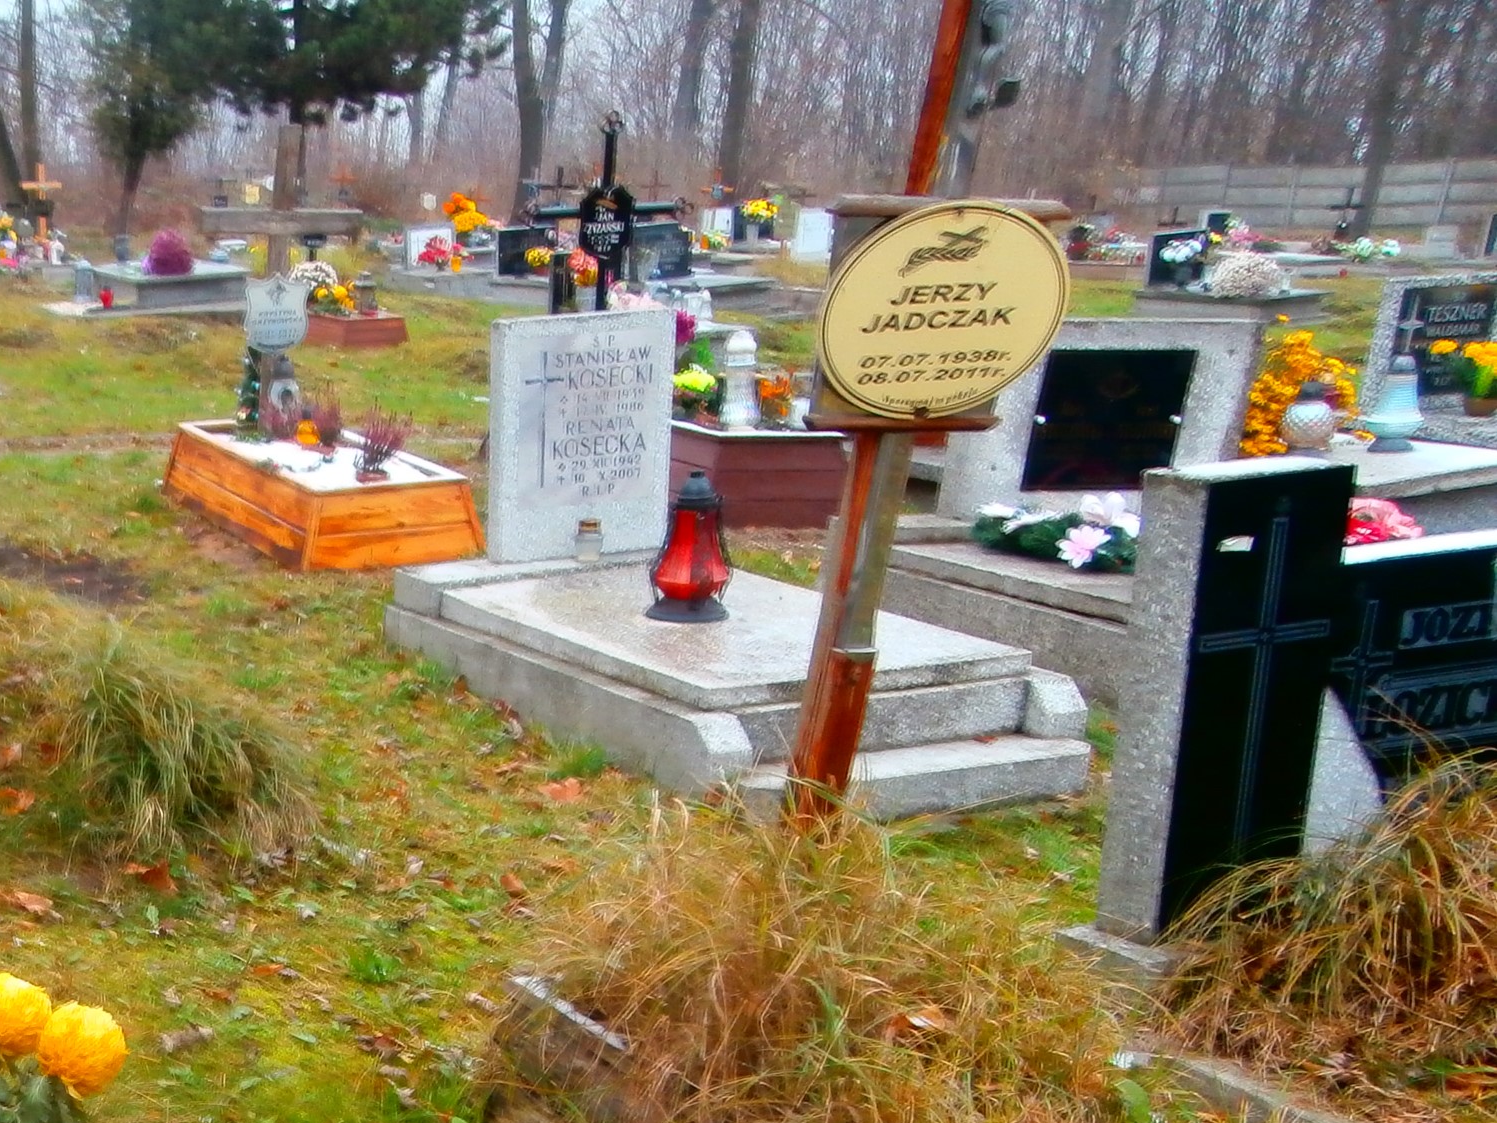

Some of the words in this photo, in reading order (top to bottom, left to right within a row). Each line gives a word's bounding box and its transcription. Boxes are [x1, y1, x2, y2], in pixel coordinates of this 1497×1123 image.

[890, 281, 998, 306] JERZY
[861, 307, 1017, 335] JADCZAK
[1427, 303, 1488, 323] TESZNER
[555, 345, 652, 369] STANISŁAW
[859, 350, 1011, 370] 07.07.1938r.
[568, 363, 653, 390] KOSECKI
[857, 367, 1006, 386] 08.07.2011r.
[566, 416, 635, 436] RENATA
[553, 432, 647, 460] KOSECKA
